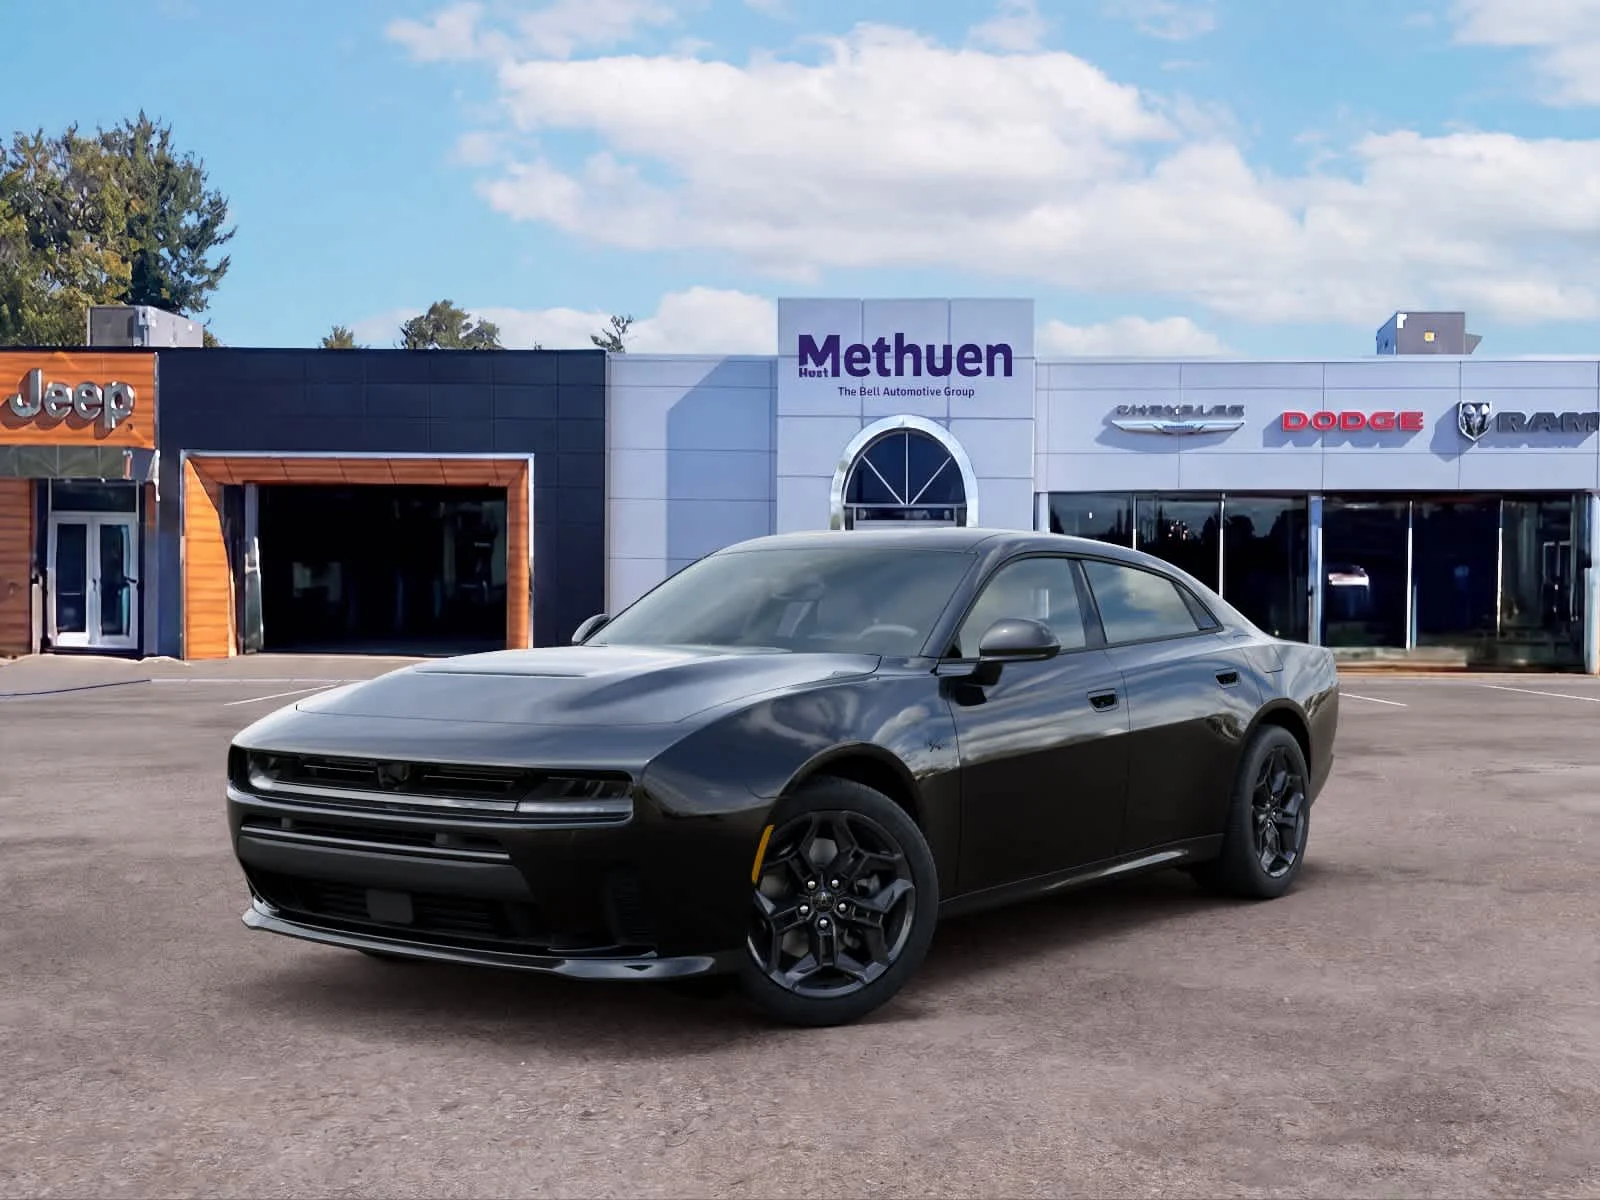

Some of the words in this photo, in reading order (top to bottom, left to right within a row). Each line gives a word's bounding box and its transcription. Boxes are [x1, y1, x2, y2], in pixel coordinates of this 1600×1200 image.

[798, 332, 1013, 378] Methuen
[9, 367, 136, 430] Jeep
[838, 386, 857, 397] The
[859, 386, 880, 397] Bell
[883, 386, 941, 397] Automotive
[943, 386, 975, 399] Group
[1282, 410, 1424, 432] DODGE
[1497, 411, 1600, 433] RAM
